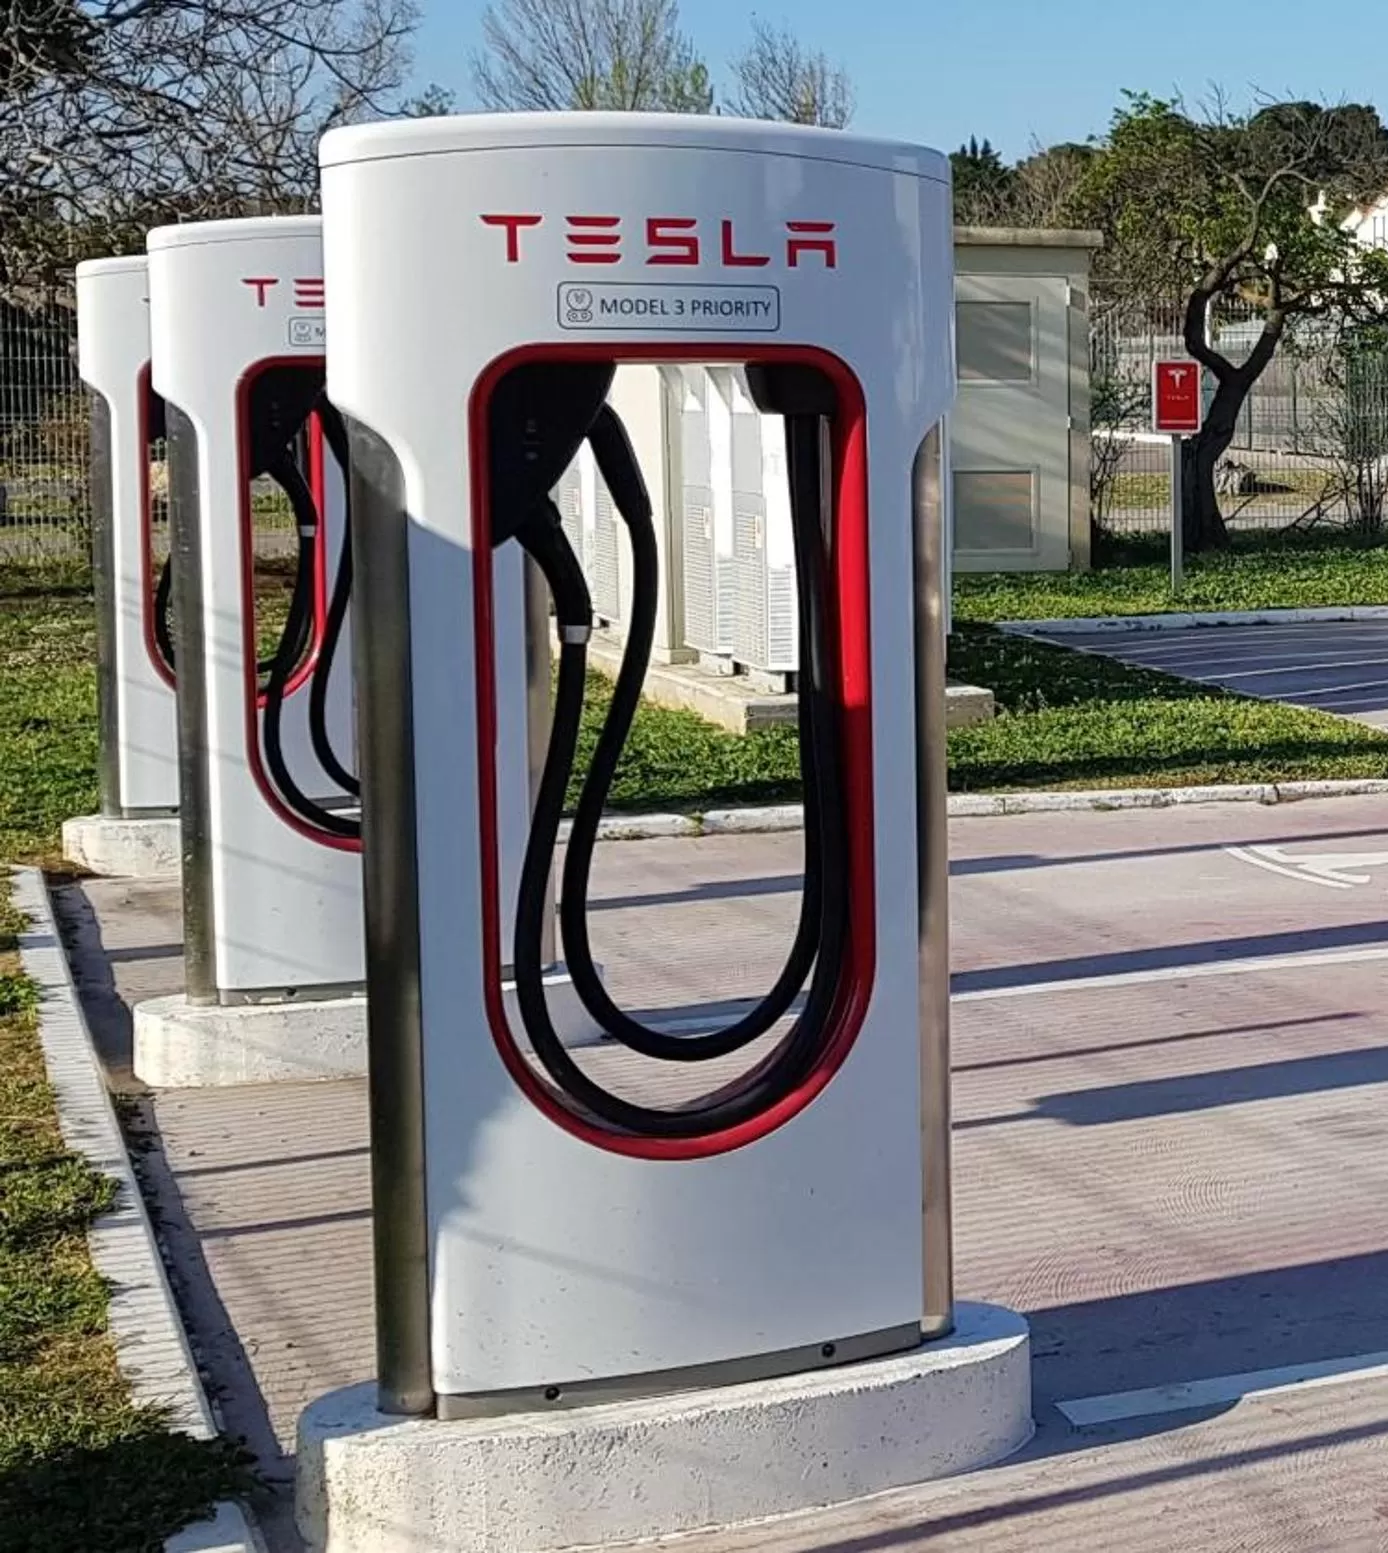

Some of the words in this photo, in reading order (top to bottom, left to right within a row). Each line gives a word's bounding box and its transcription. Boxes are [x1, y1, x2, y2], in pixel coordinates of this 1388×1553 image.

[480, 214, 836, 268] TESLA
[601, 298, 669, 316] MODEL
[675, 300, 686, 316] 3
[691, 300, 772, 317] PRIORITY
